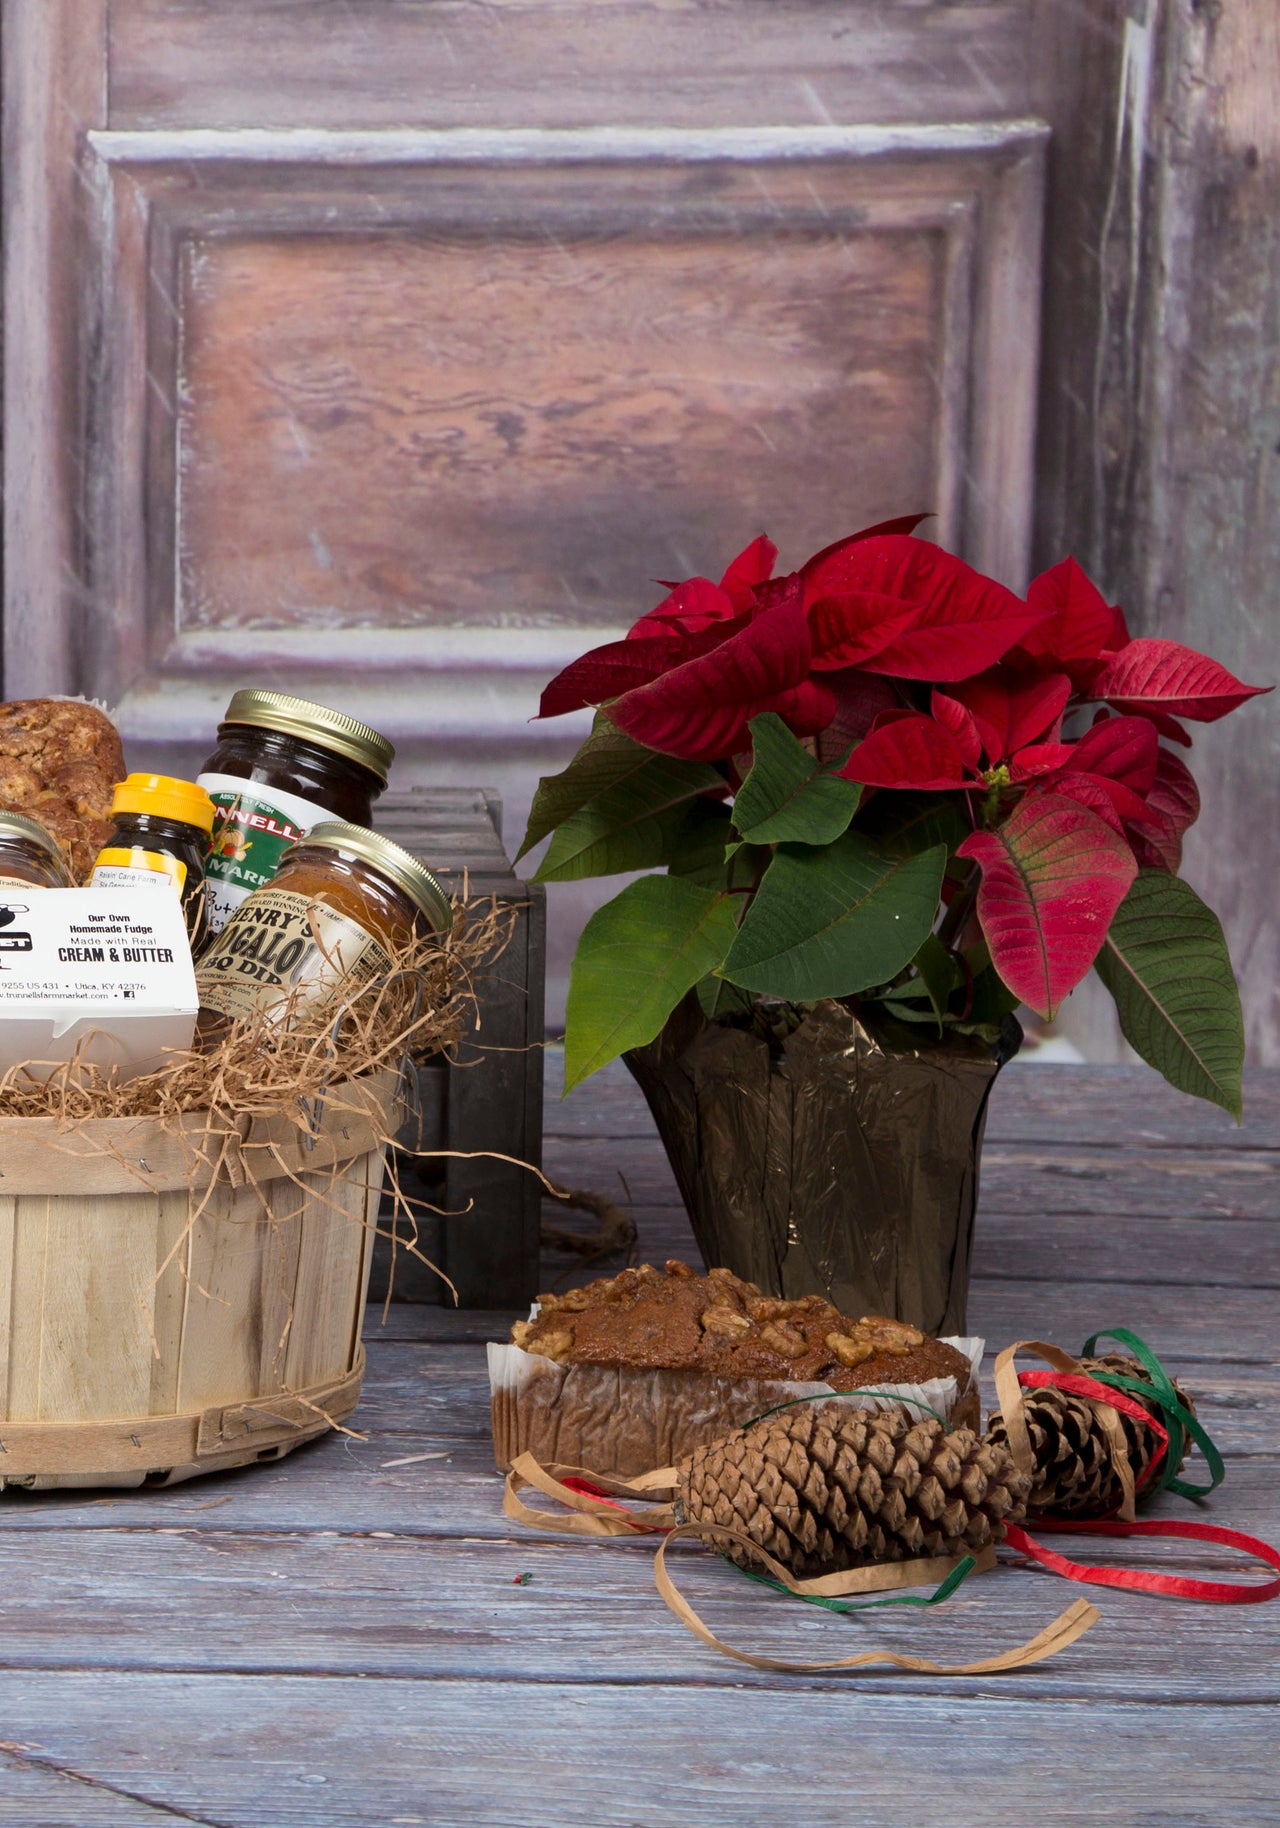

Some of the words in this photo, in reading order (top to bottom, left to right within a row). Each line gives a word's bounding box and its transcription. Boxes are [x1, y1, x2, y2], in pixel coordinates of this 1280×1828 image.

[273, 900, 307, 915] WINNING
[286, 895, 320, 911] WILDGAE
[88, 914, 106, 923] Our
[109, 914, 131, 923] Own
[69, 924, 122, 934] Homemade
[124, 925, 153, 935] Fudge
[70, 937, 101, 946] Made
[105, 937, 128, 946] with
[131, 937, 157, 946] Real
[58, 947, 105, 963] CREAM
[109, 947, 120, 962] &
[124, 948, 174, 963] BUTTER
[236, 960, 282, 985] DIP
[1, 982, 25, 990] 9255
[26, 982, 41, 990] US
[42, 982, 59, 990] 431
[74, 982, 100, 991] Utica,
[117, 983, 147, 991] 42376
